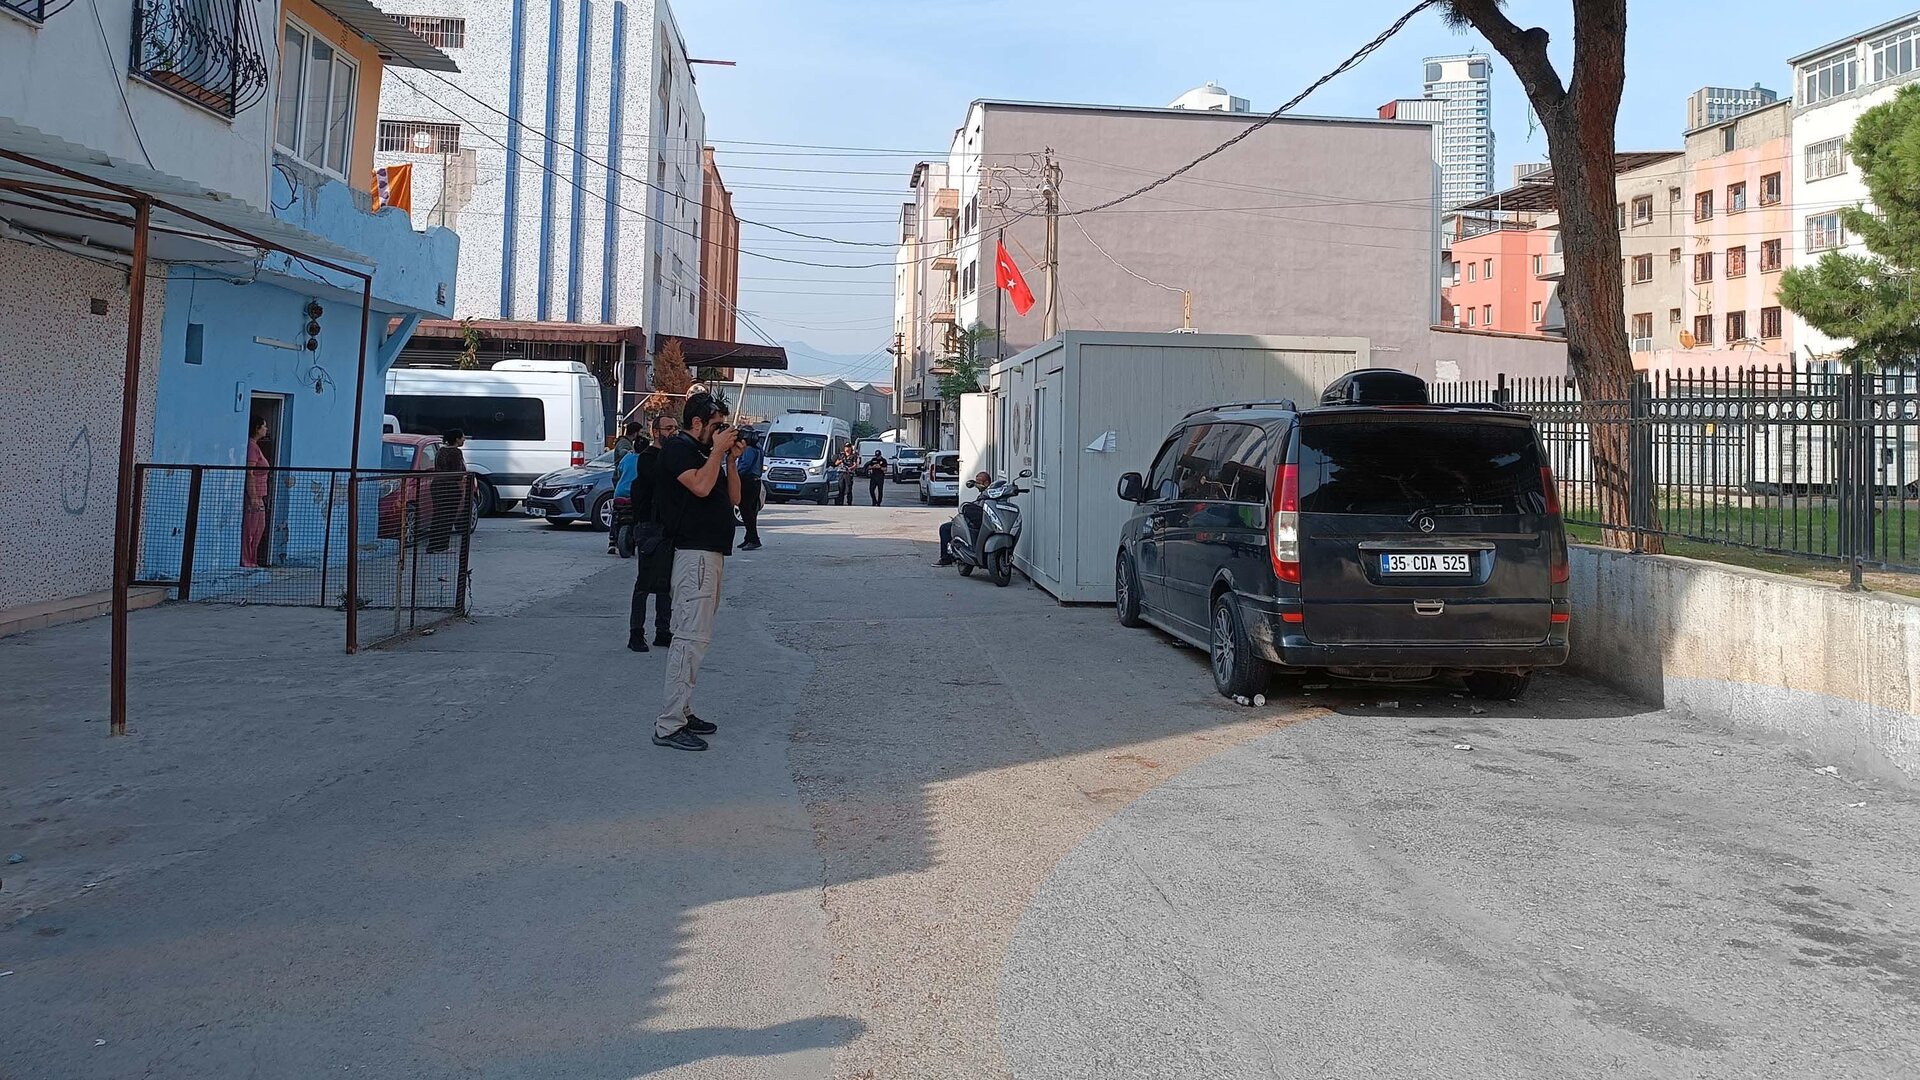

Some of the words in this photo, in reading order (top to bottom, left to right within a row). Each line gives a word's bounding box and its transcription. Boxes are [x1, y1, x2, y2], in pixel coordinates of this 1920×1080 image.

[1705, 97, 1761, 106] FOLKART
[1390, 556, 1406, 571] 35
[1413, 556, 1437, 571] CDA
[1442, 556, 1466, 571] 525
